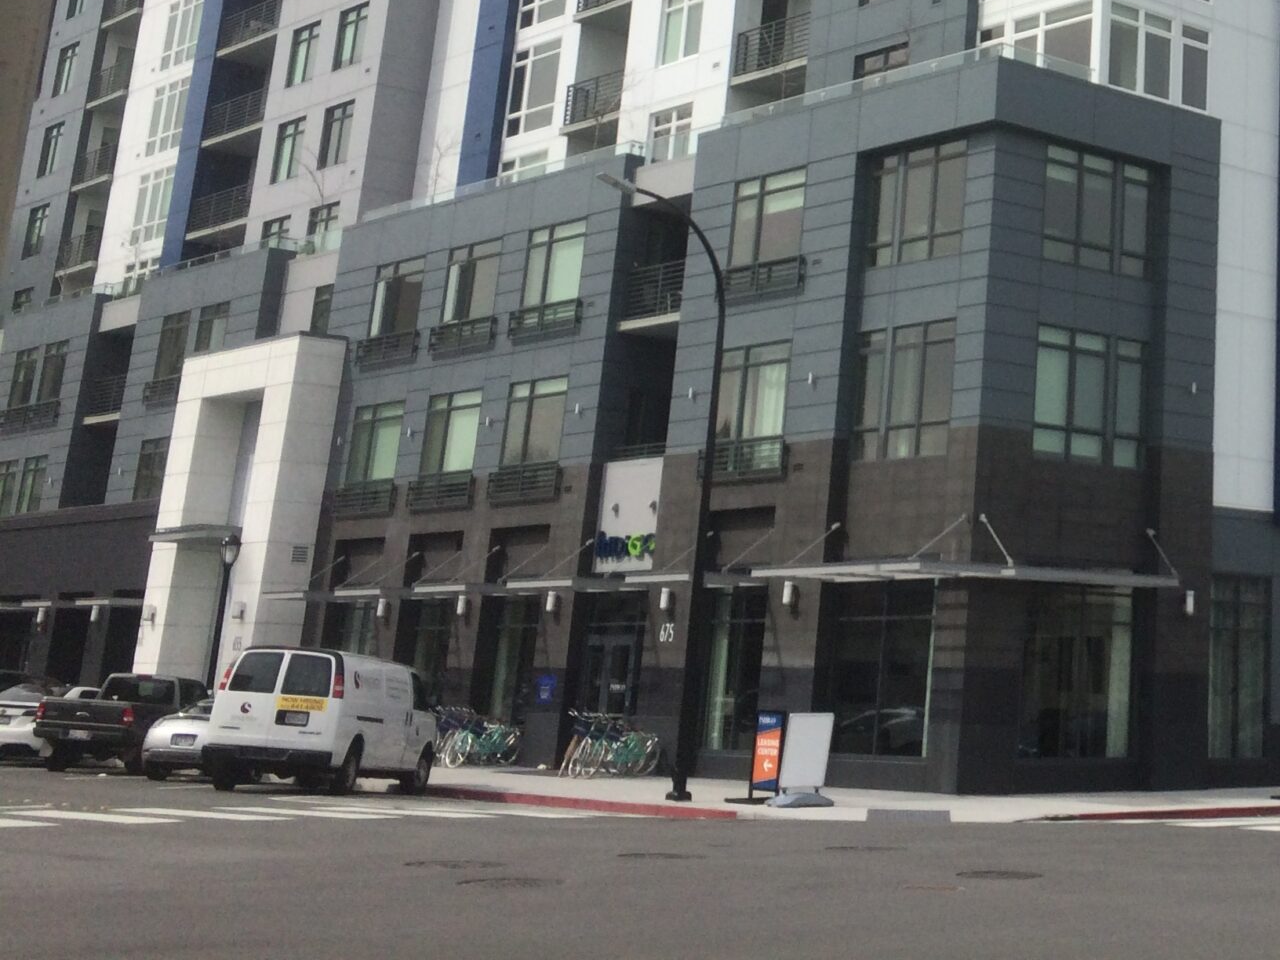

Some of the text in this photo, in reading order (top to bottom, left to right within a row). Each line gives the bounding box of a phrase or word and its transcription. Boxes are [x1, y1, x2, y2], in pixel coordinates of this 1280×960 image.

[659, 623, 675, 642] 675
[757, 738, 780, 747] LEASING
[757, 747, 778, 756] CENTER
